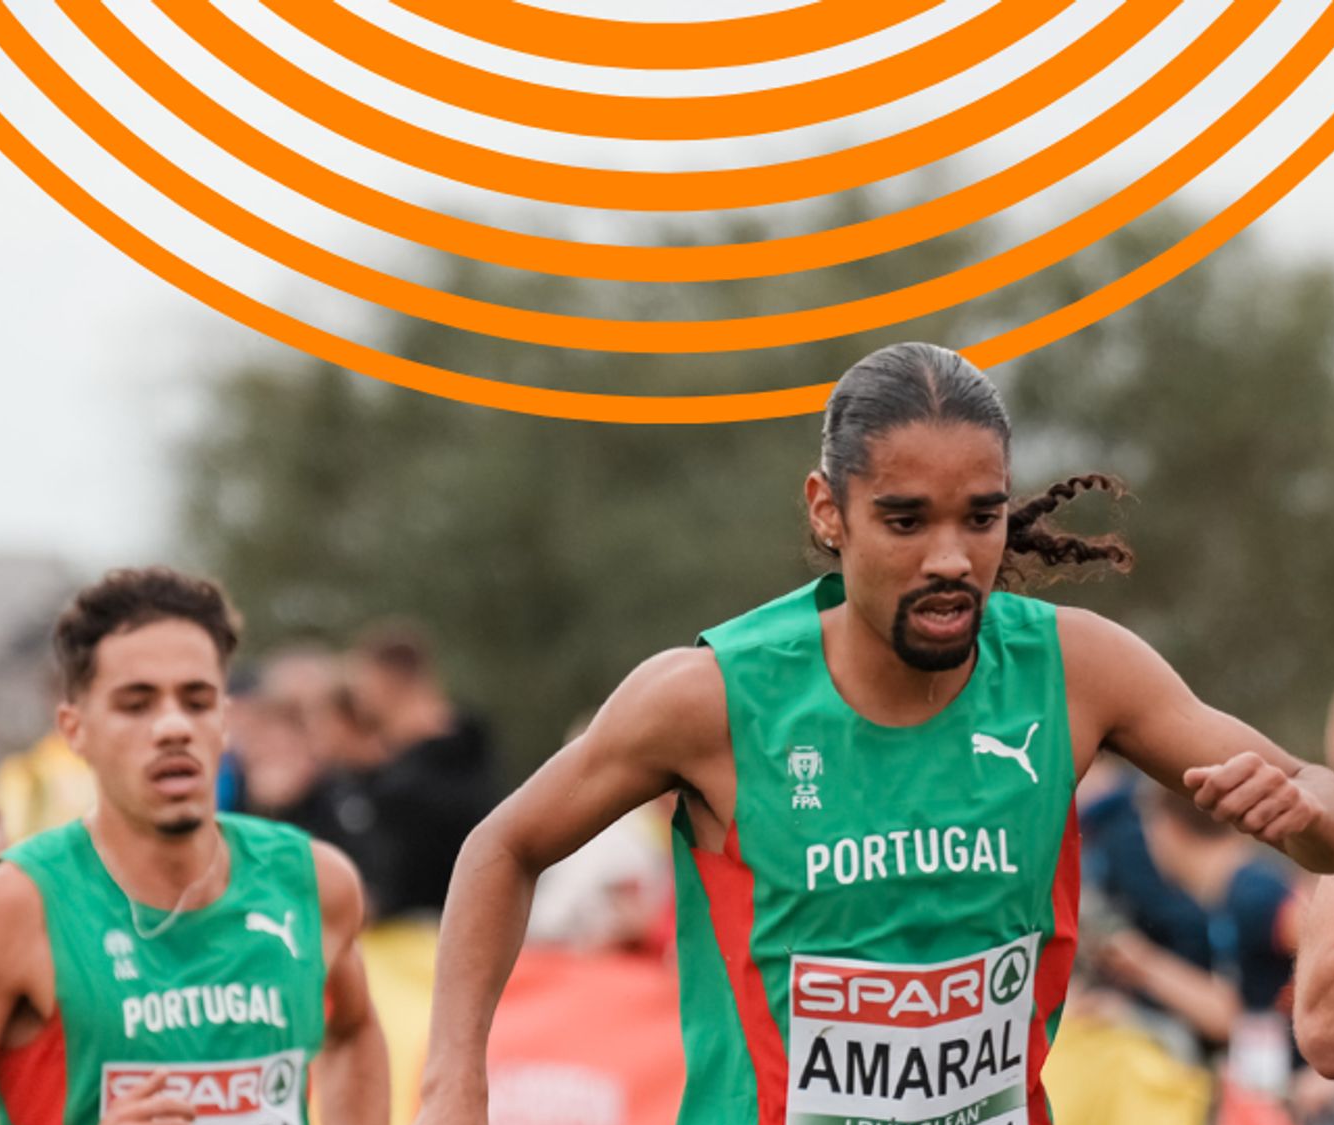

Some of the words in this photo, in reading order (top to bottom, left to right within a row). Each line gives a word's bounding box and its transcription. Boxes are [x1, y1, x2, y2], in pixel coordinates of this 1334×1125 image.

[806, 826, 1017, 890] PORTUGAL
[122, 982, 286, 1039] PORTUGAL
[798, 969, 980, 1018] SPAR
[798, 1020, 1021, 1100] AMARAL
